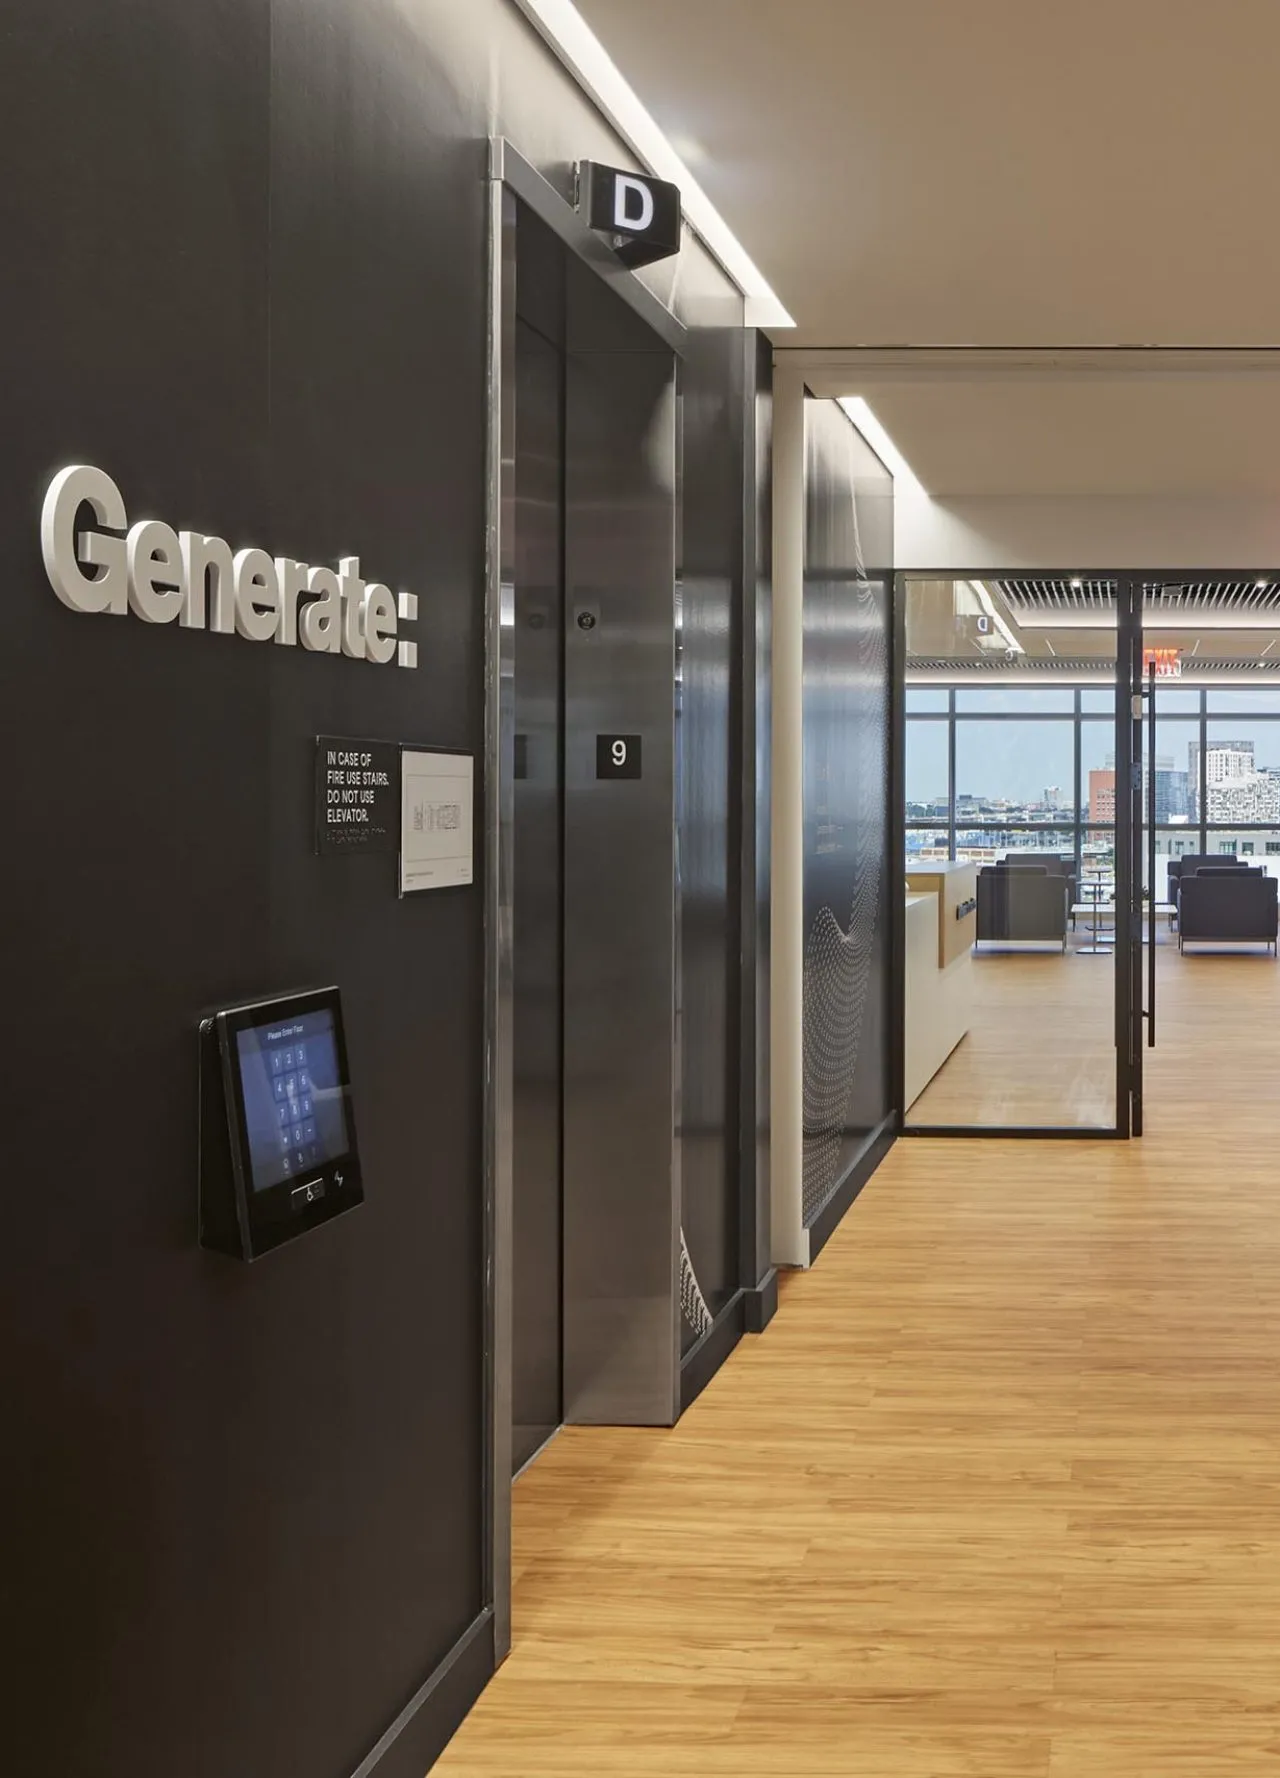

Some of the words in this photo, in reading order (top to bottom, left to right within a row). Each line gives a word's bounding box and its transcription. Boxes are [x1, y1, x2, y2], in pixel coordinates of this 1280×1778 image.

[614, 173, 654, 231] D
[41, 464, 418, 669] Generate:
[327, 751, 336, 765] IN
[338, 753, 358, 766] CASE
[360, 754, 371, 767] OF
[611, 740, 627, 766] 9
[327, 771, 344, 784] FIRE
[347, 772, 361, 785] USE
[363, 772, 389, 786] STAIRS.
[327, 790, 339, 803] DO
[342, 790, 358, 803] NOT
[360, 791, 374, 803] USE
[327, 809, 369, 823] ELEVATOR.
